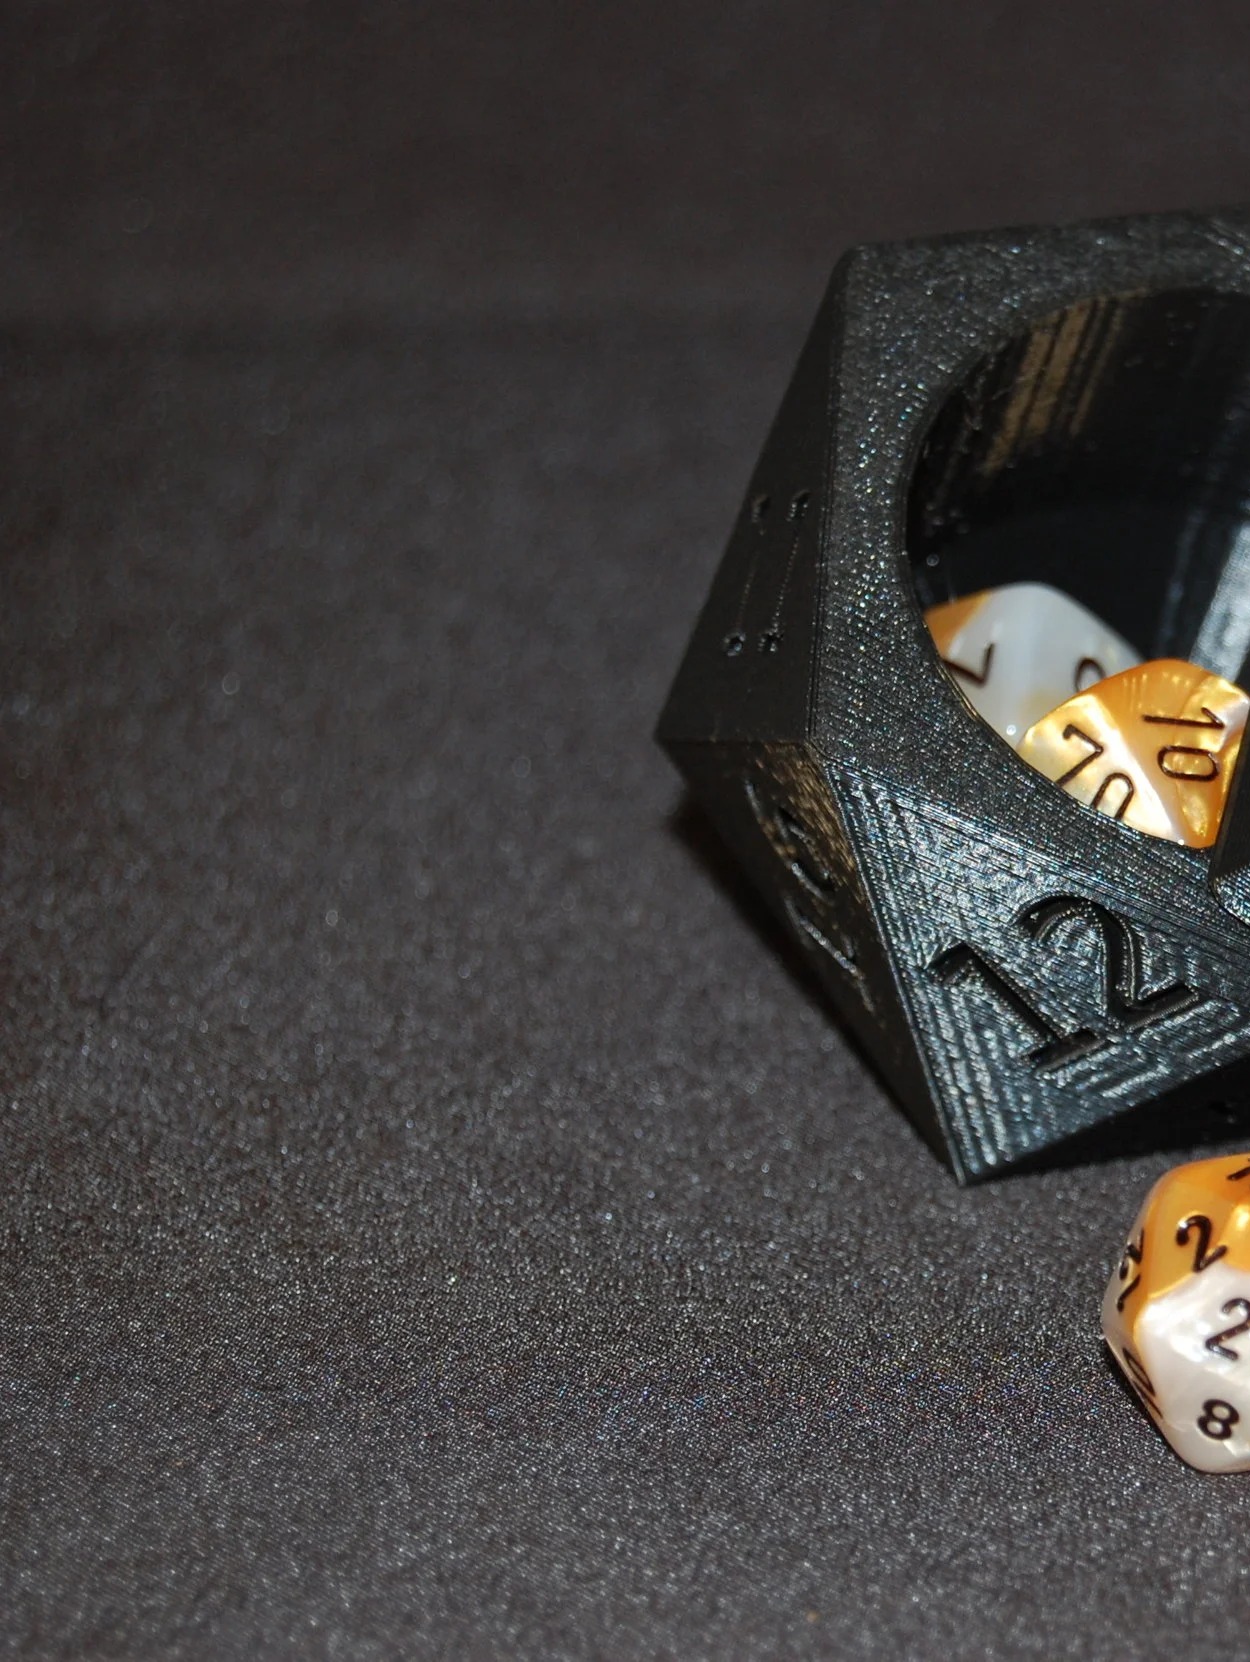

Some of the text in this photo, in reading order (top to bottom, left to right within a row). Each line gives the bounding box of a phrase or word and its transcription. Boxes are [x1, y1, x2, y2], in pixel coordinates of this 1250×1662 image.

[1142, 706, 1226, 783] 10
[921, 890, 1201, 1074] 12
[1175, 1213, 1229, 1275] 2
[1196, 1398, 1241, 1442] 8
